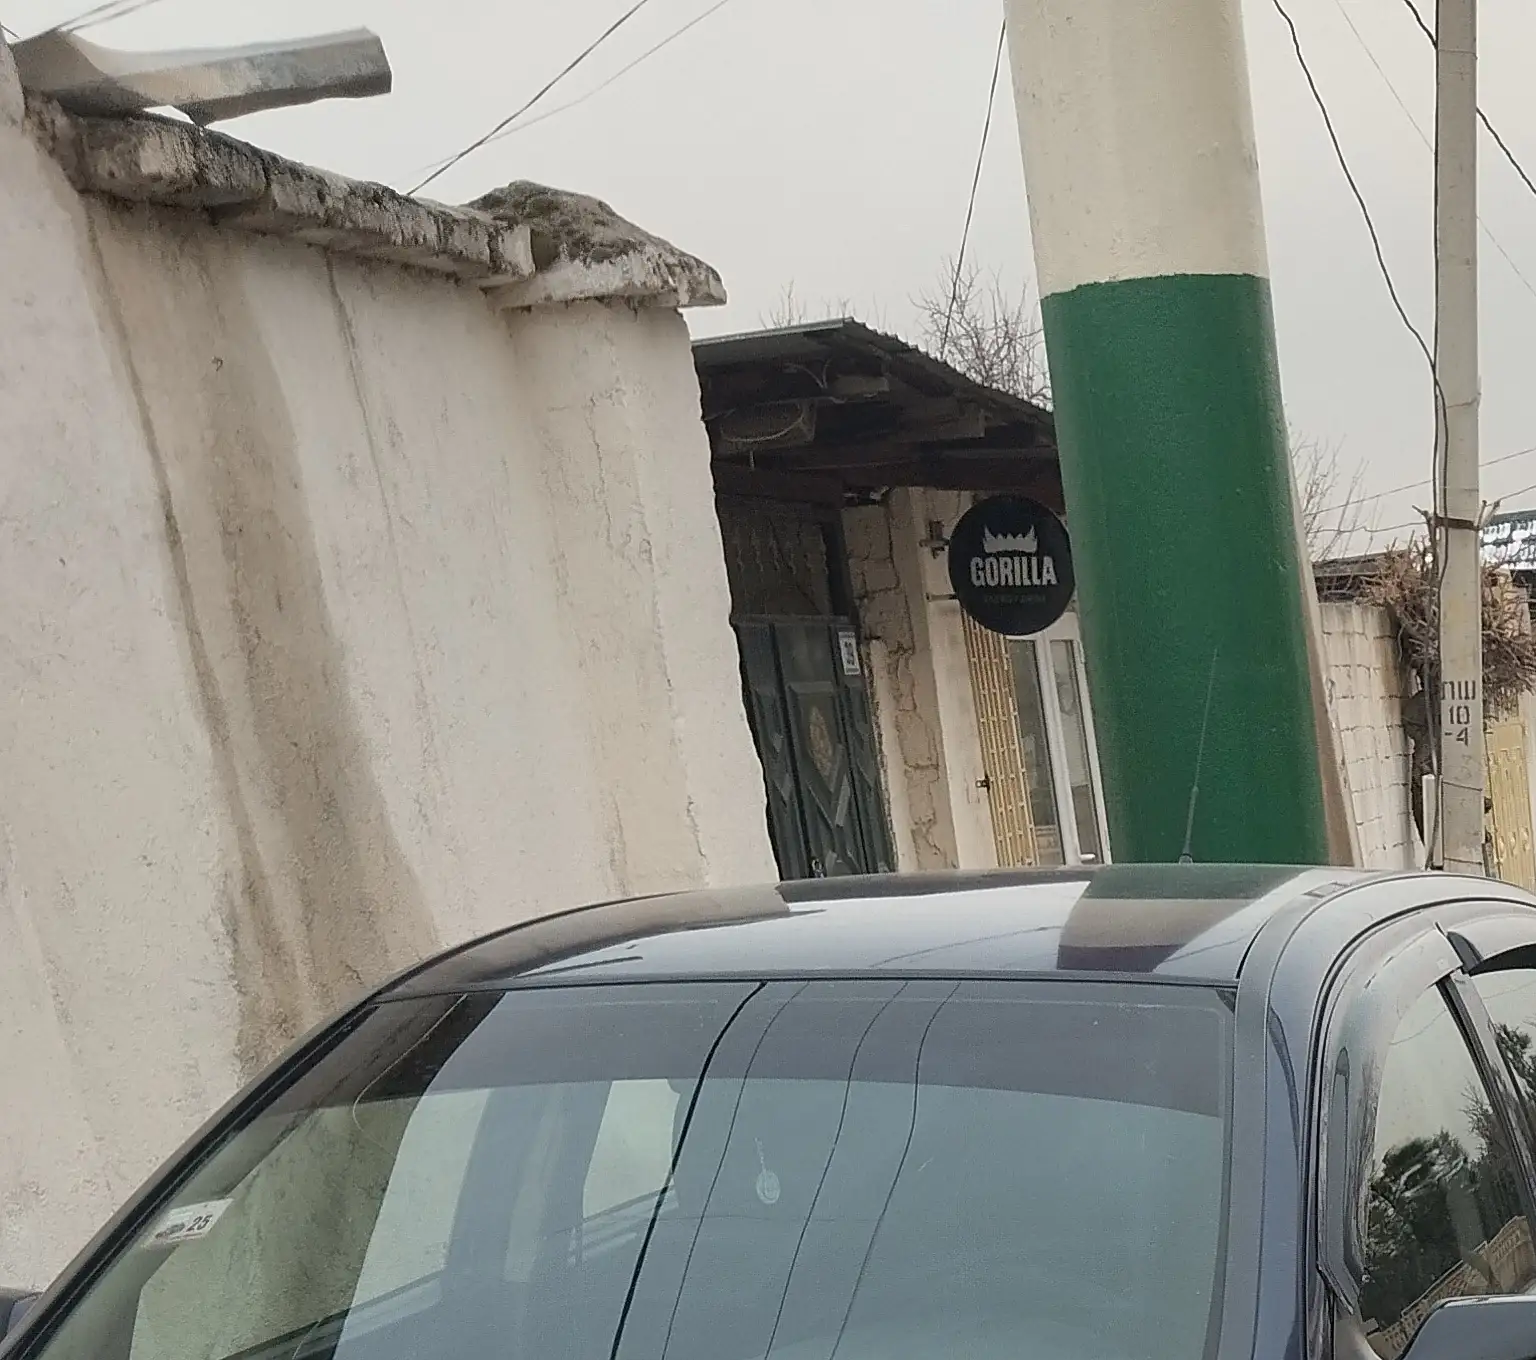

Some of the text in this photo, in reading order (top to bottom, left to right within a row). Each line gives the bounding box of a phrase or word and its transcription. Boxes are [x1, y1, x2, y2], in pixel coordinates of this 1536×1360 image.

[970, 556, 1057, 586] GORILLA
[1449, 706, 1470, 725] 10
[186, 1214, 213, 1233] 25
